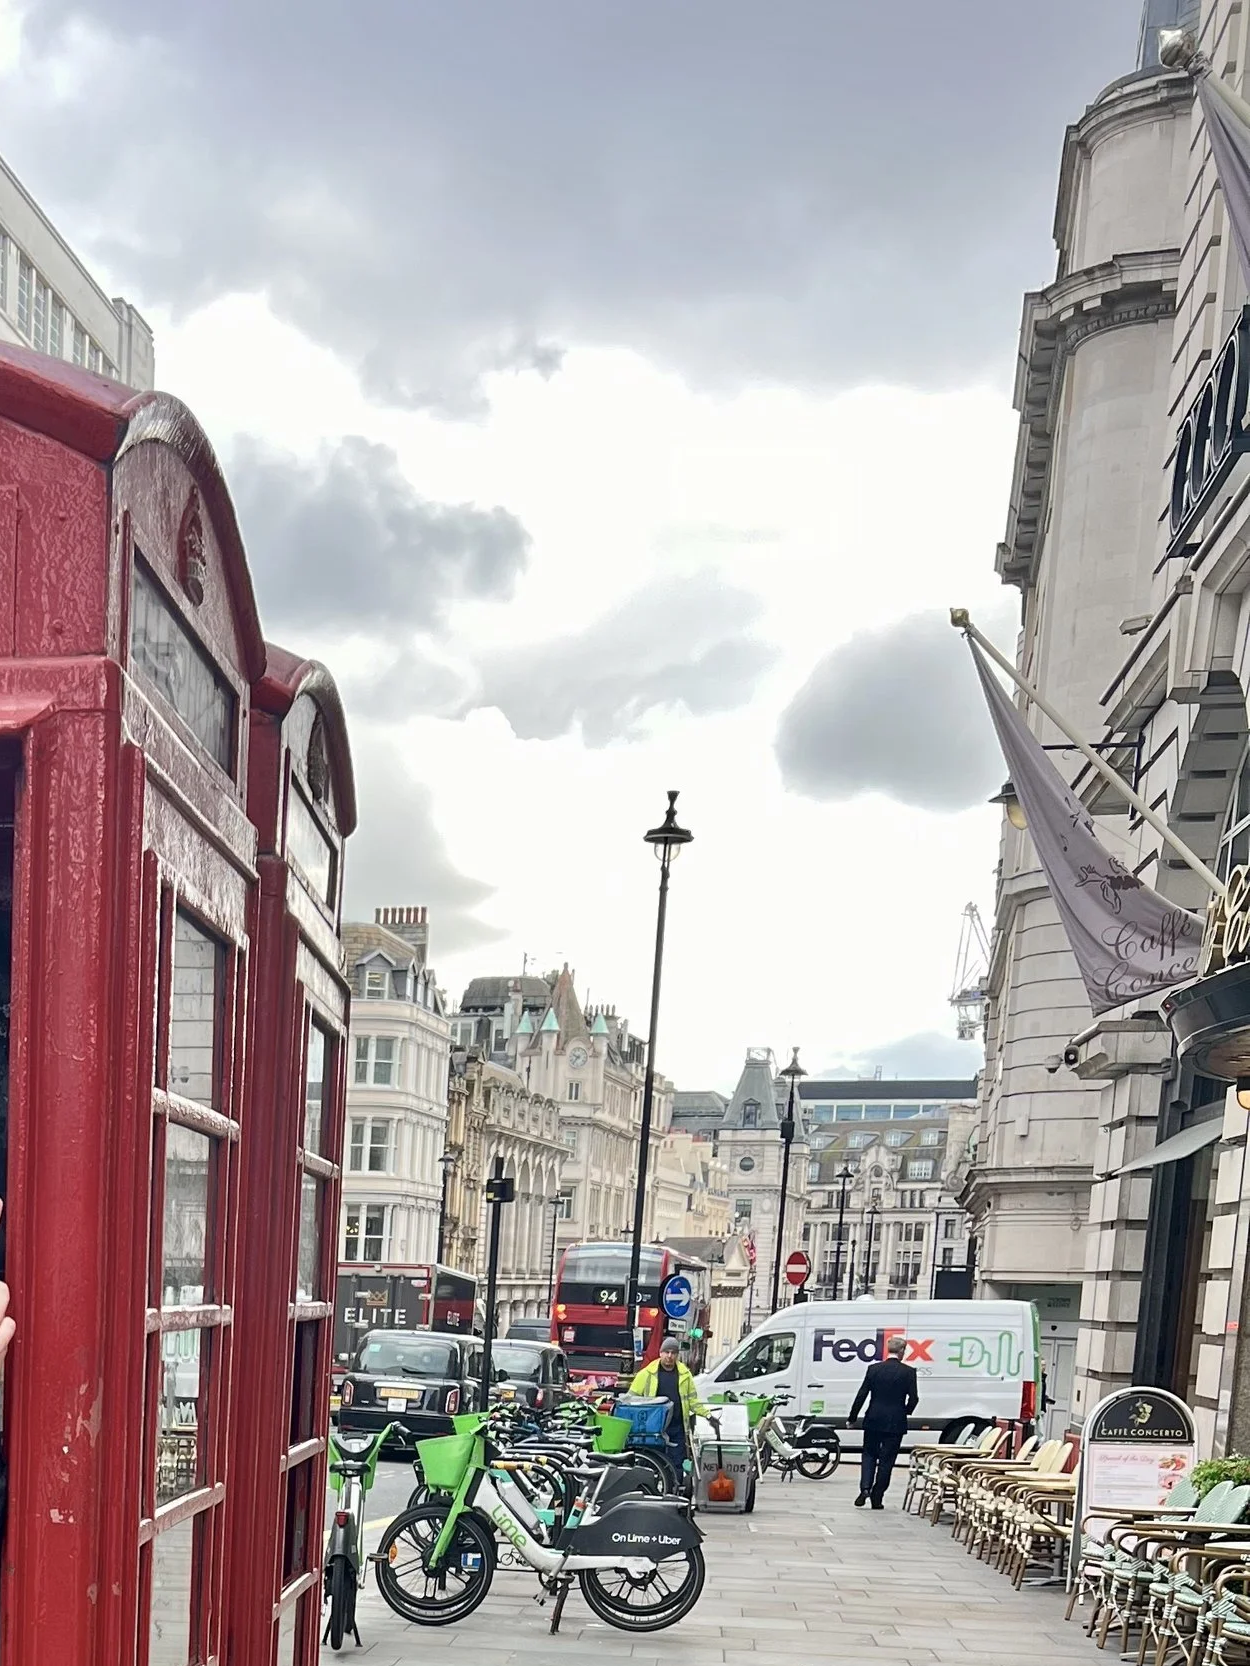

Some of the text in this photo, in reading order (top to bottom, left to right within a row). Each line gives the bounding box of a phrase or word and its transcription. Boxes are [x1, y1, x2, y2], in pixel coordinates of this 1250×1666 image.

[600, 1290, 618, 1303] 94
[344, 1307, 407, 1325] ELITE
[1130, 1429, 1183, 1437] CONCERTO
[492, 1504, 527, 1549] Lime
[611, 1532, 626, 1543] On
[627, 1533, 650, 1544] Lime
[658, 1533, 682, 1545] Uber
